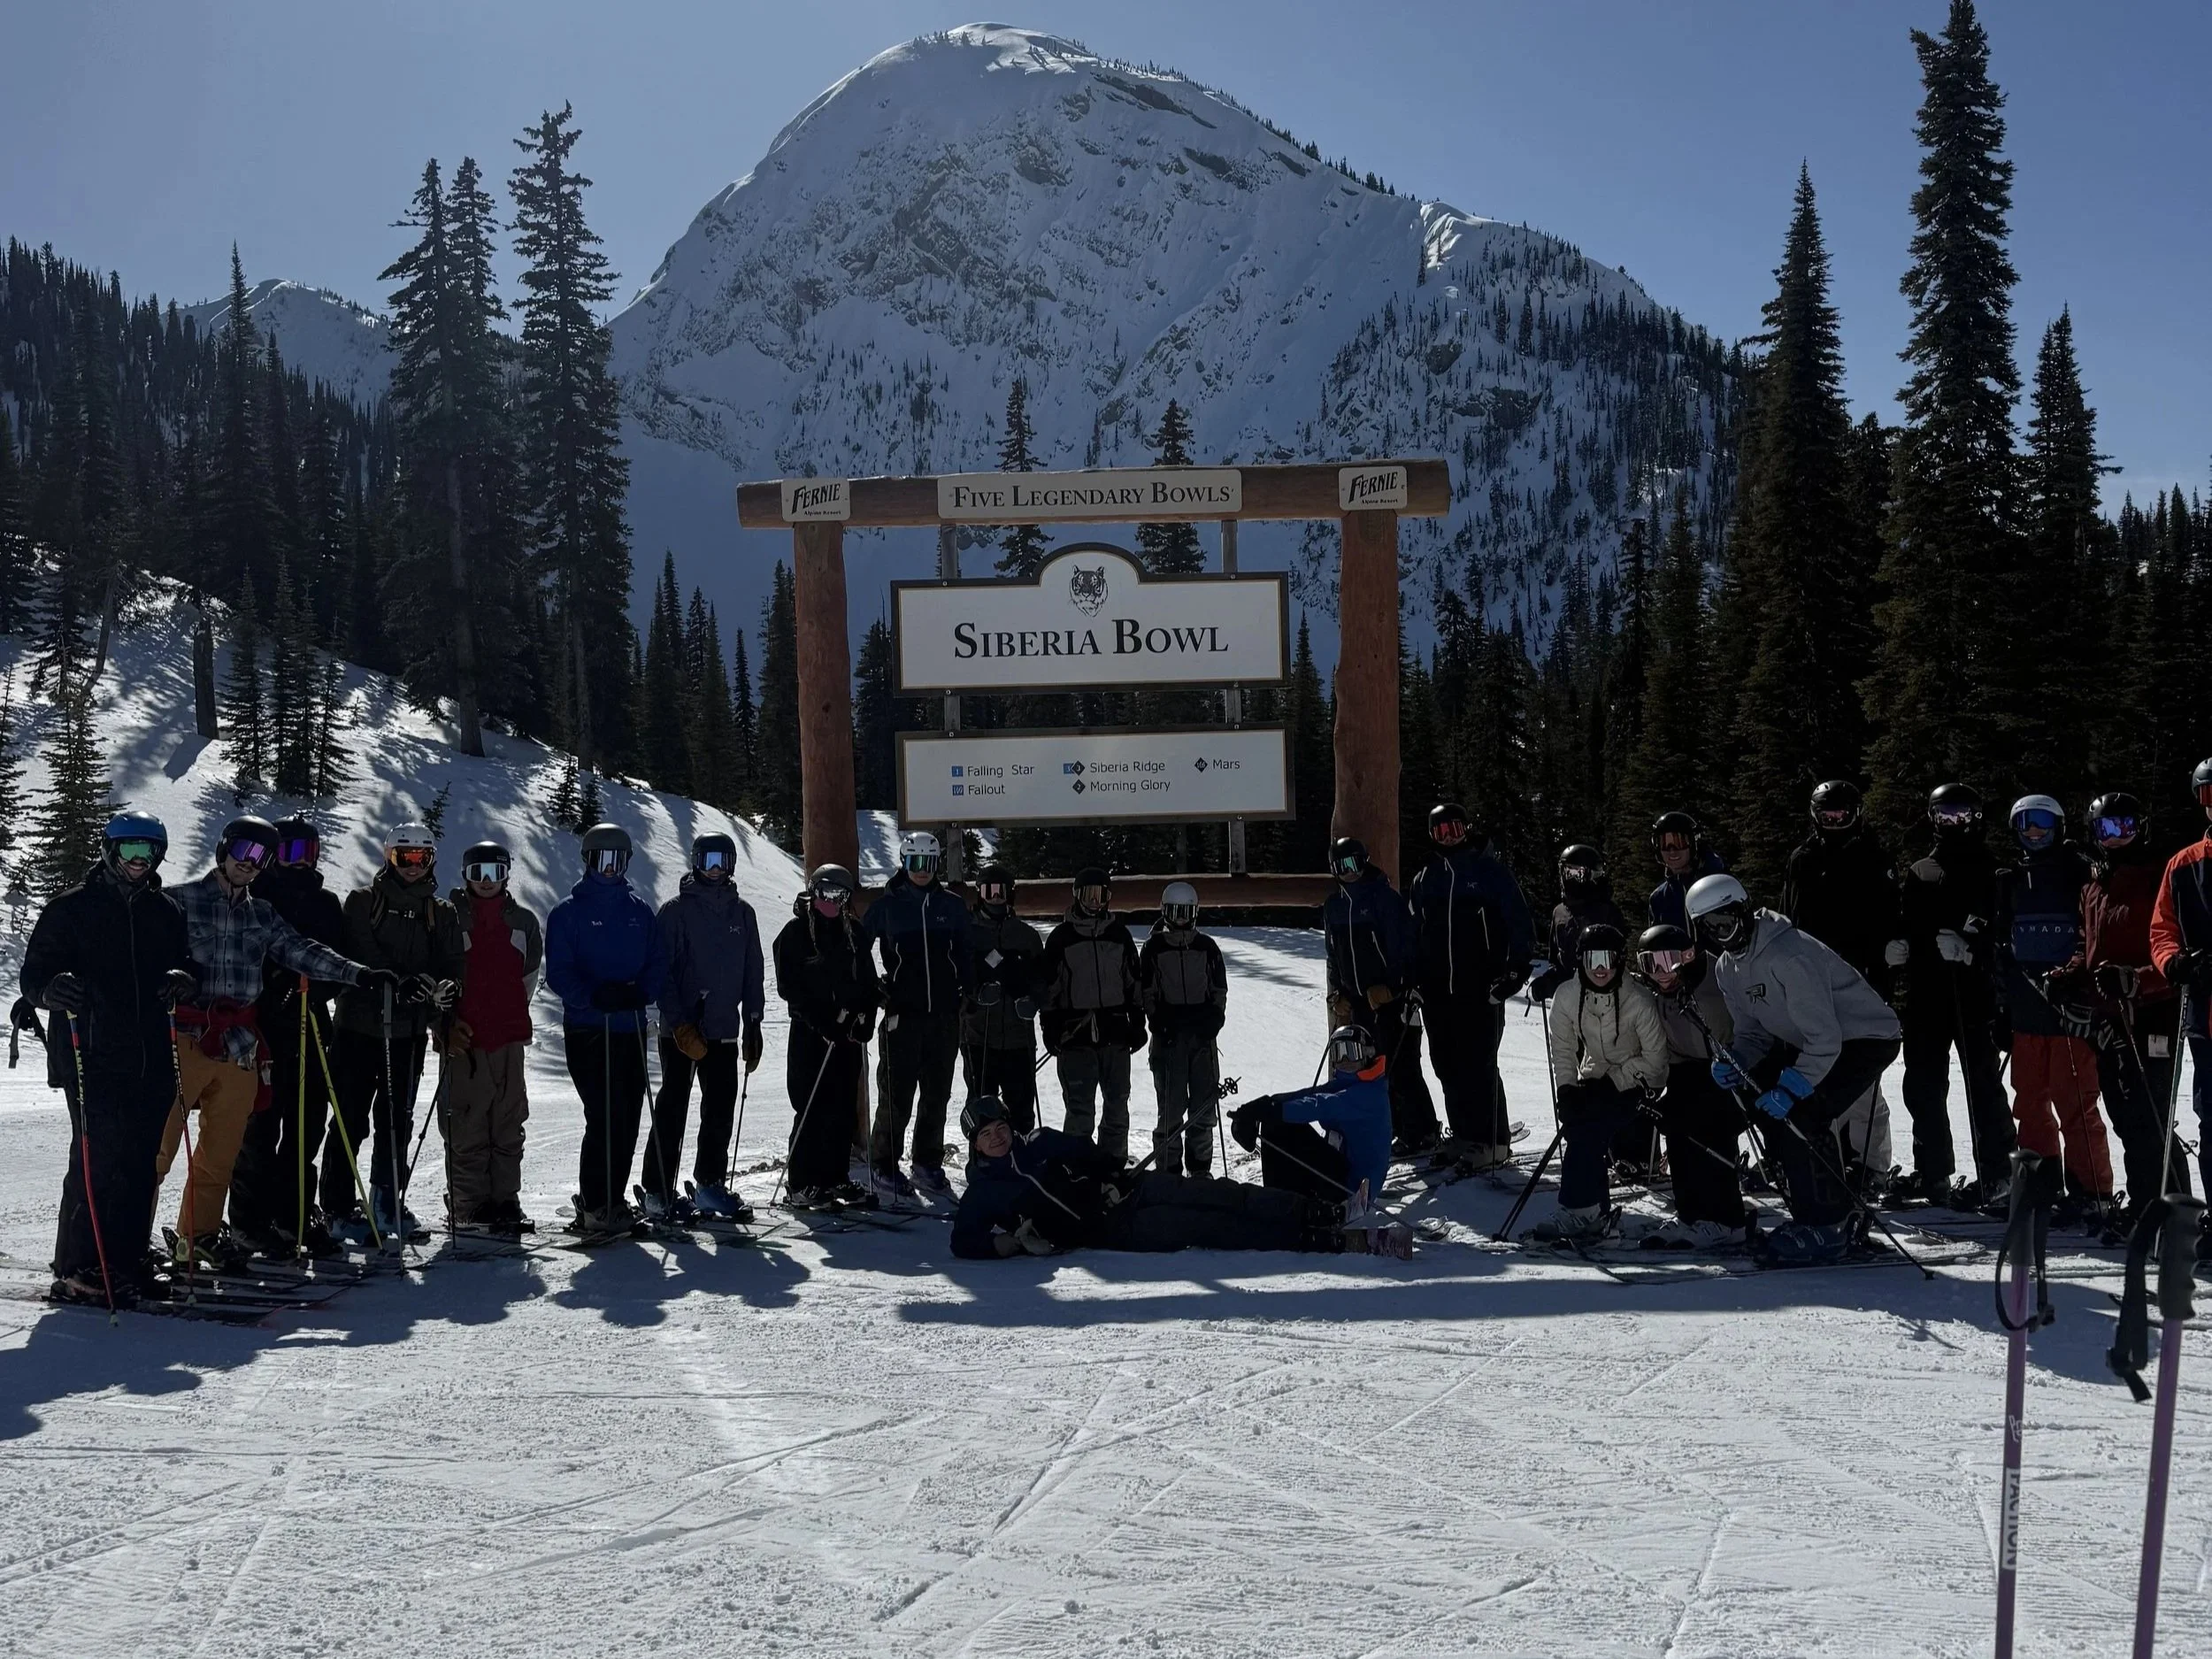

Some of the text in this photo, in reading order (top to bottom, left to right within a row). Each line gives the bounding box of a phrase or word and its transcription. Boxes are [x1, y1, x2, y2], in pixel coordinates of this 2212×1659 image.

[953, 481, 1231, 508] FIVE LEGENDARY BOWLS
[1348, 472, 1398, 504] FERNIE
[791, 483, 841, 515] FERNIE
[954, 618, 1229, 659] SIBERIA BOWL
[967, 765, 1003, 779] Falling
[1011, 764, 1035, 775] Star
[1090, 762, 1129, 773] Siberia
[1133, 760, 1166, 774] Ridge
[1212, 759, 1240, 770] Mars
[968, 784, 1006, 795] Fallout
[1090, 780, 1137, 793] Morning
[1141, 780, 1171, 792] Glory
